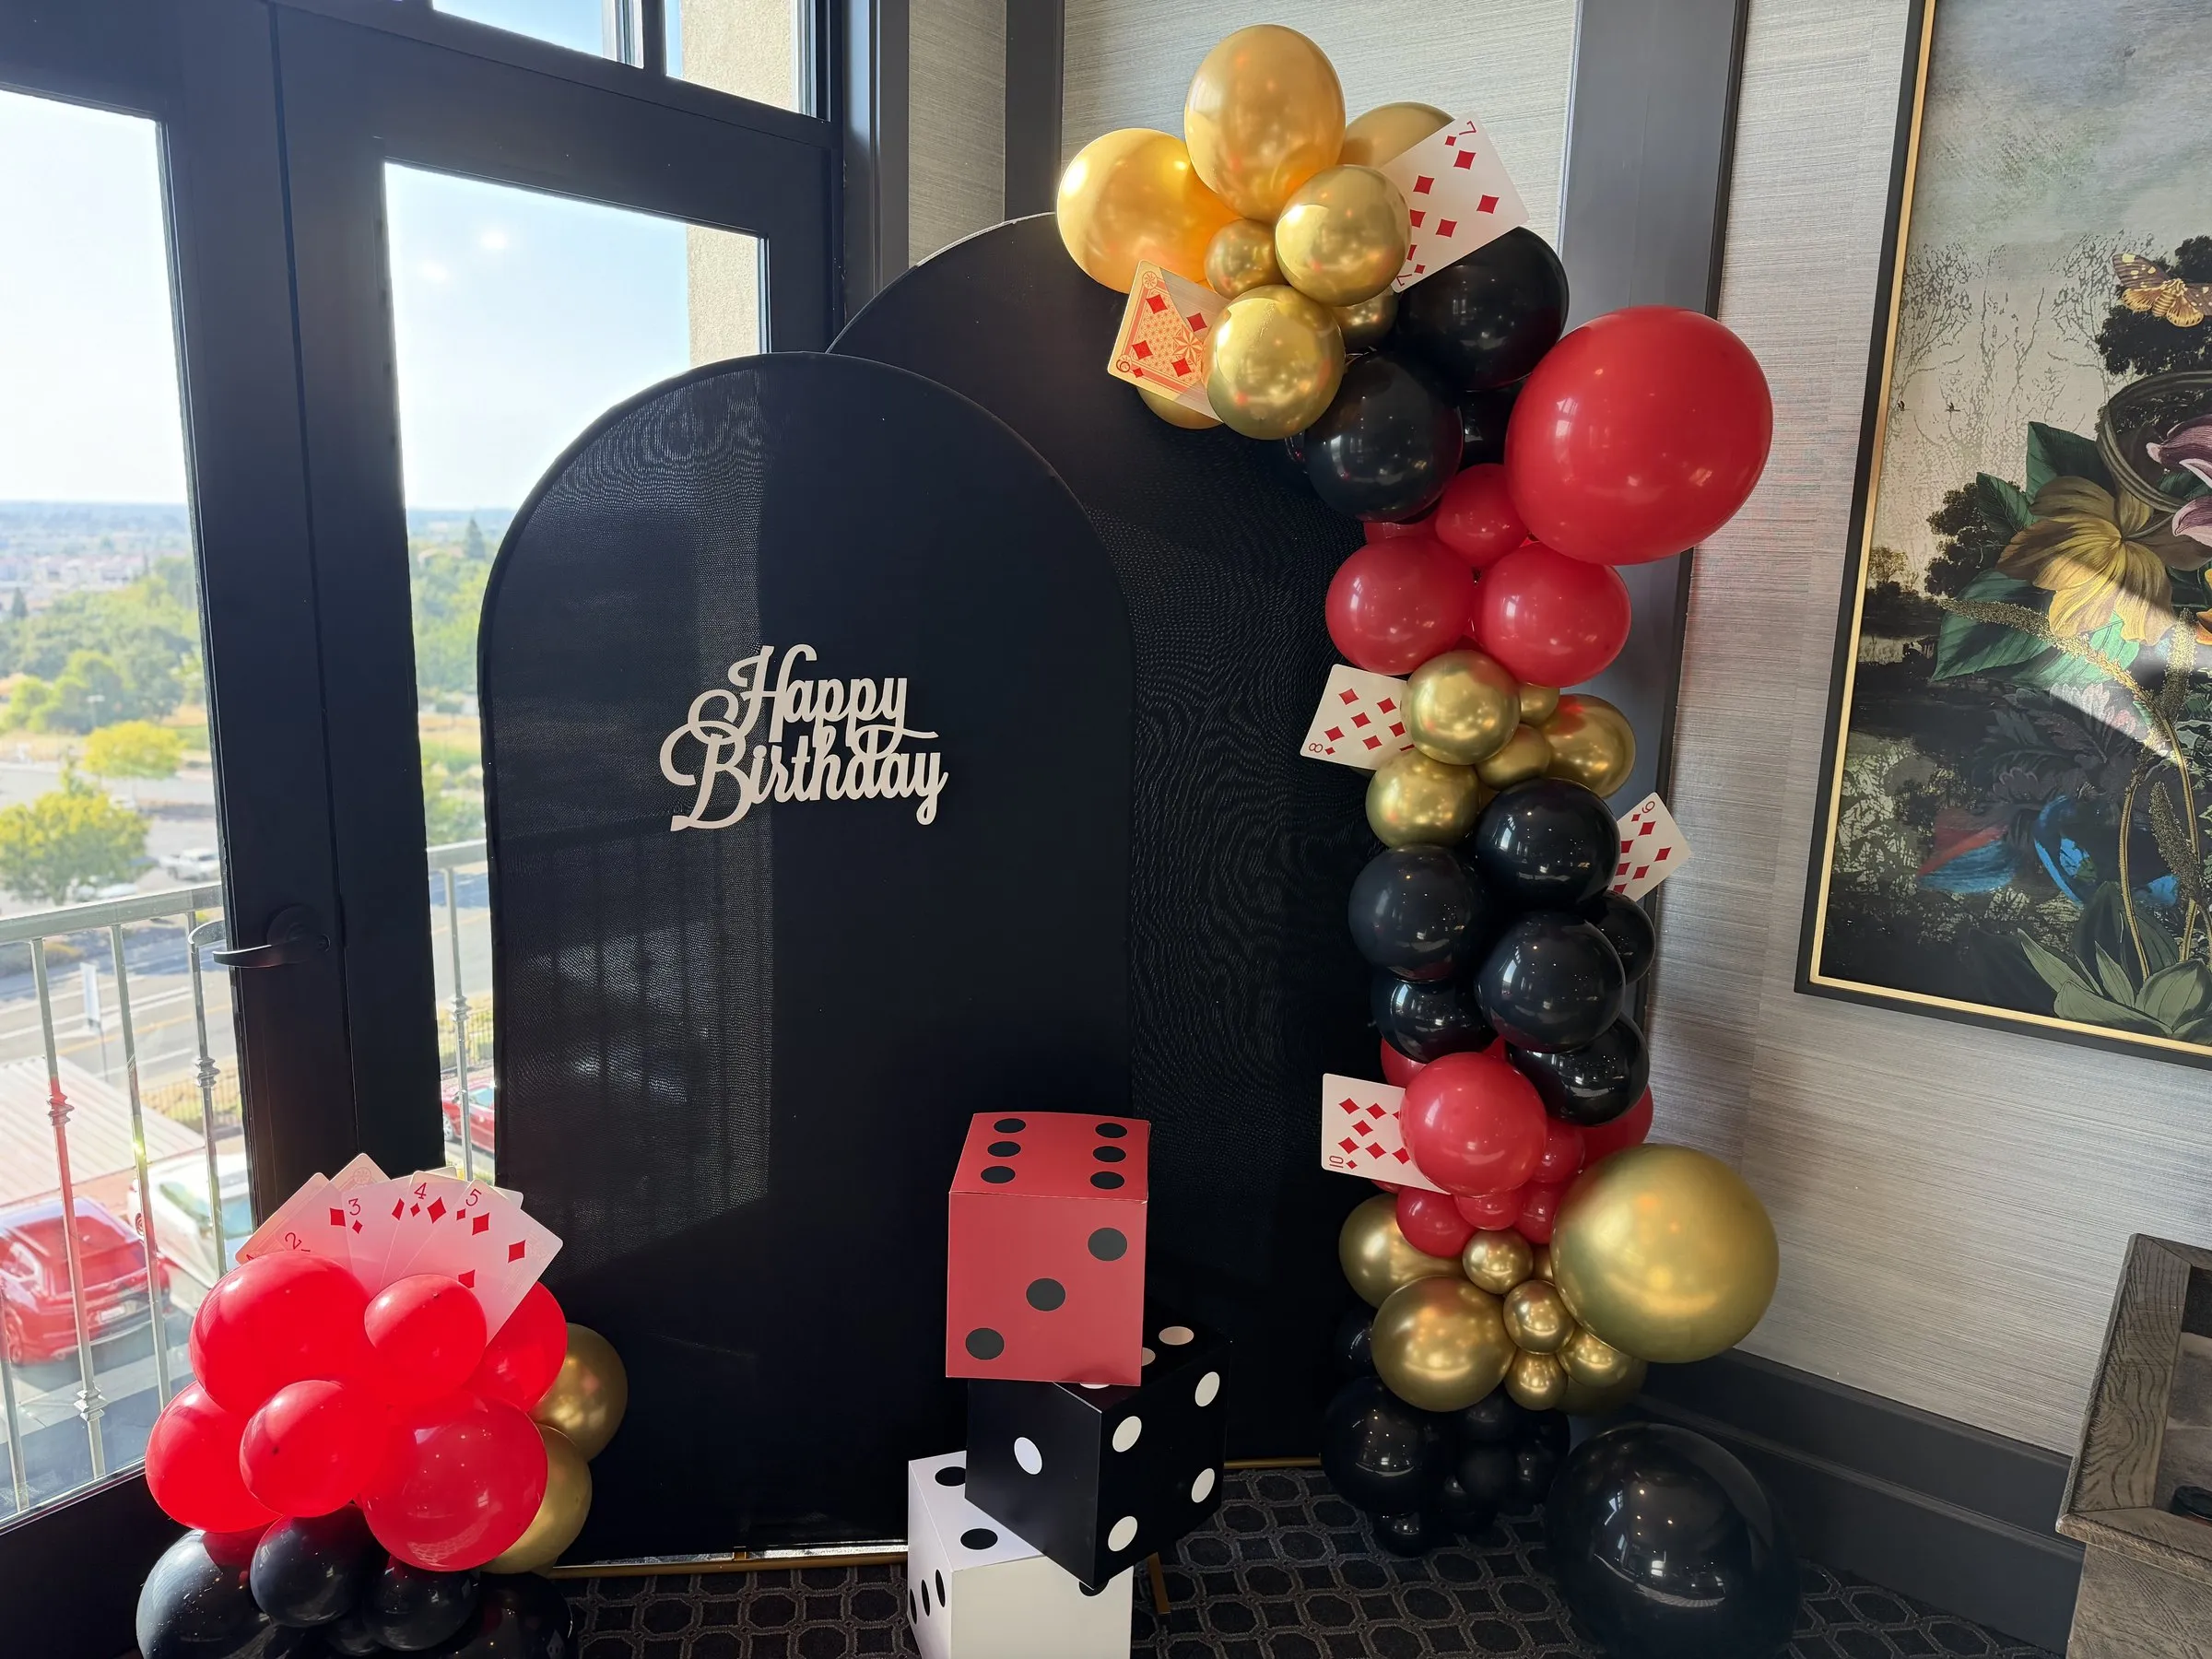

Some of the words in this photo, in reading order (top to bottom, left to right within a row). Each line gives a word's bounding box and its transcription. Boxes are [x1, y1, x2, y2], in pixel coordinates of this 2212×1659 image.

[1458, 121, 1478, 135] 7
[1116, 359, 1130, 372] 6
[687, 643, 939, 758] Happy
[1309, 742, 1324, 753] 8
[660, 721, 948, 831] Birthday
[1641, 800, 1656, 814] 9
[1329, 1155, 1344, 1168] 10
[413, 1182, 427, 1200] 4
[465, 1188, 482, 1206] 5
[347, 1197, 361, 1216] 3
[285, 1232, 302, 1250] 2
